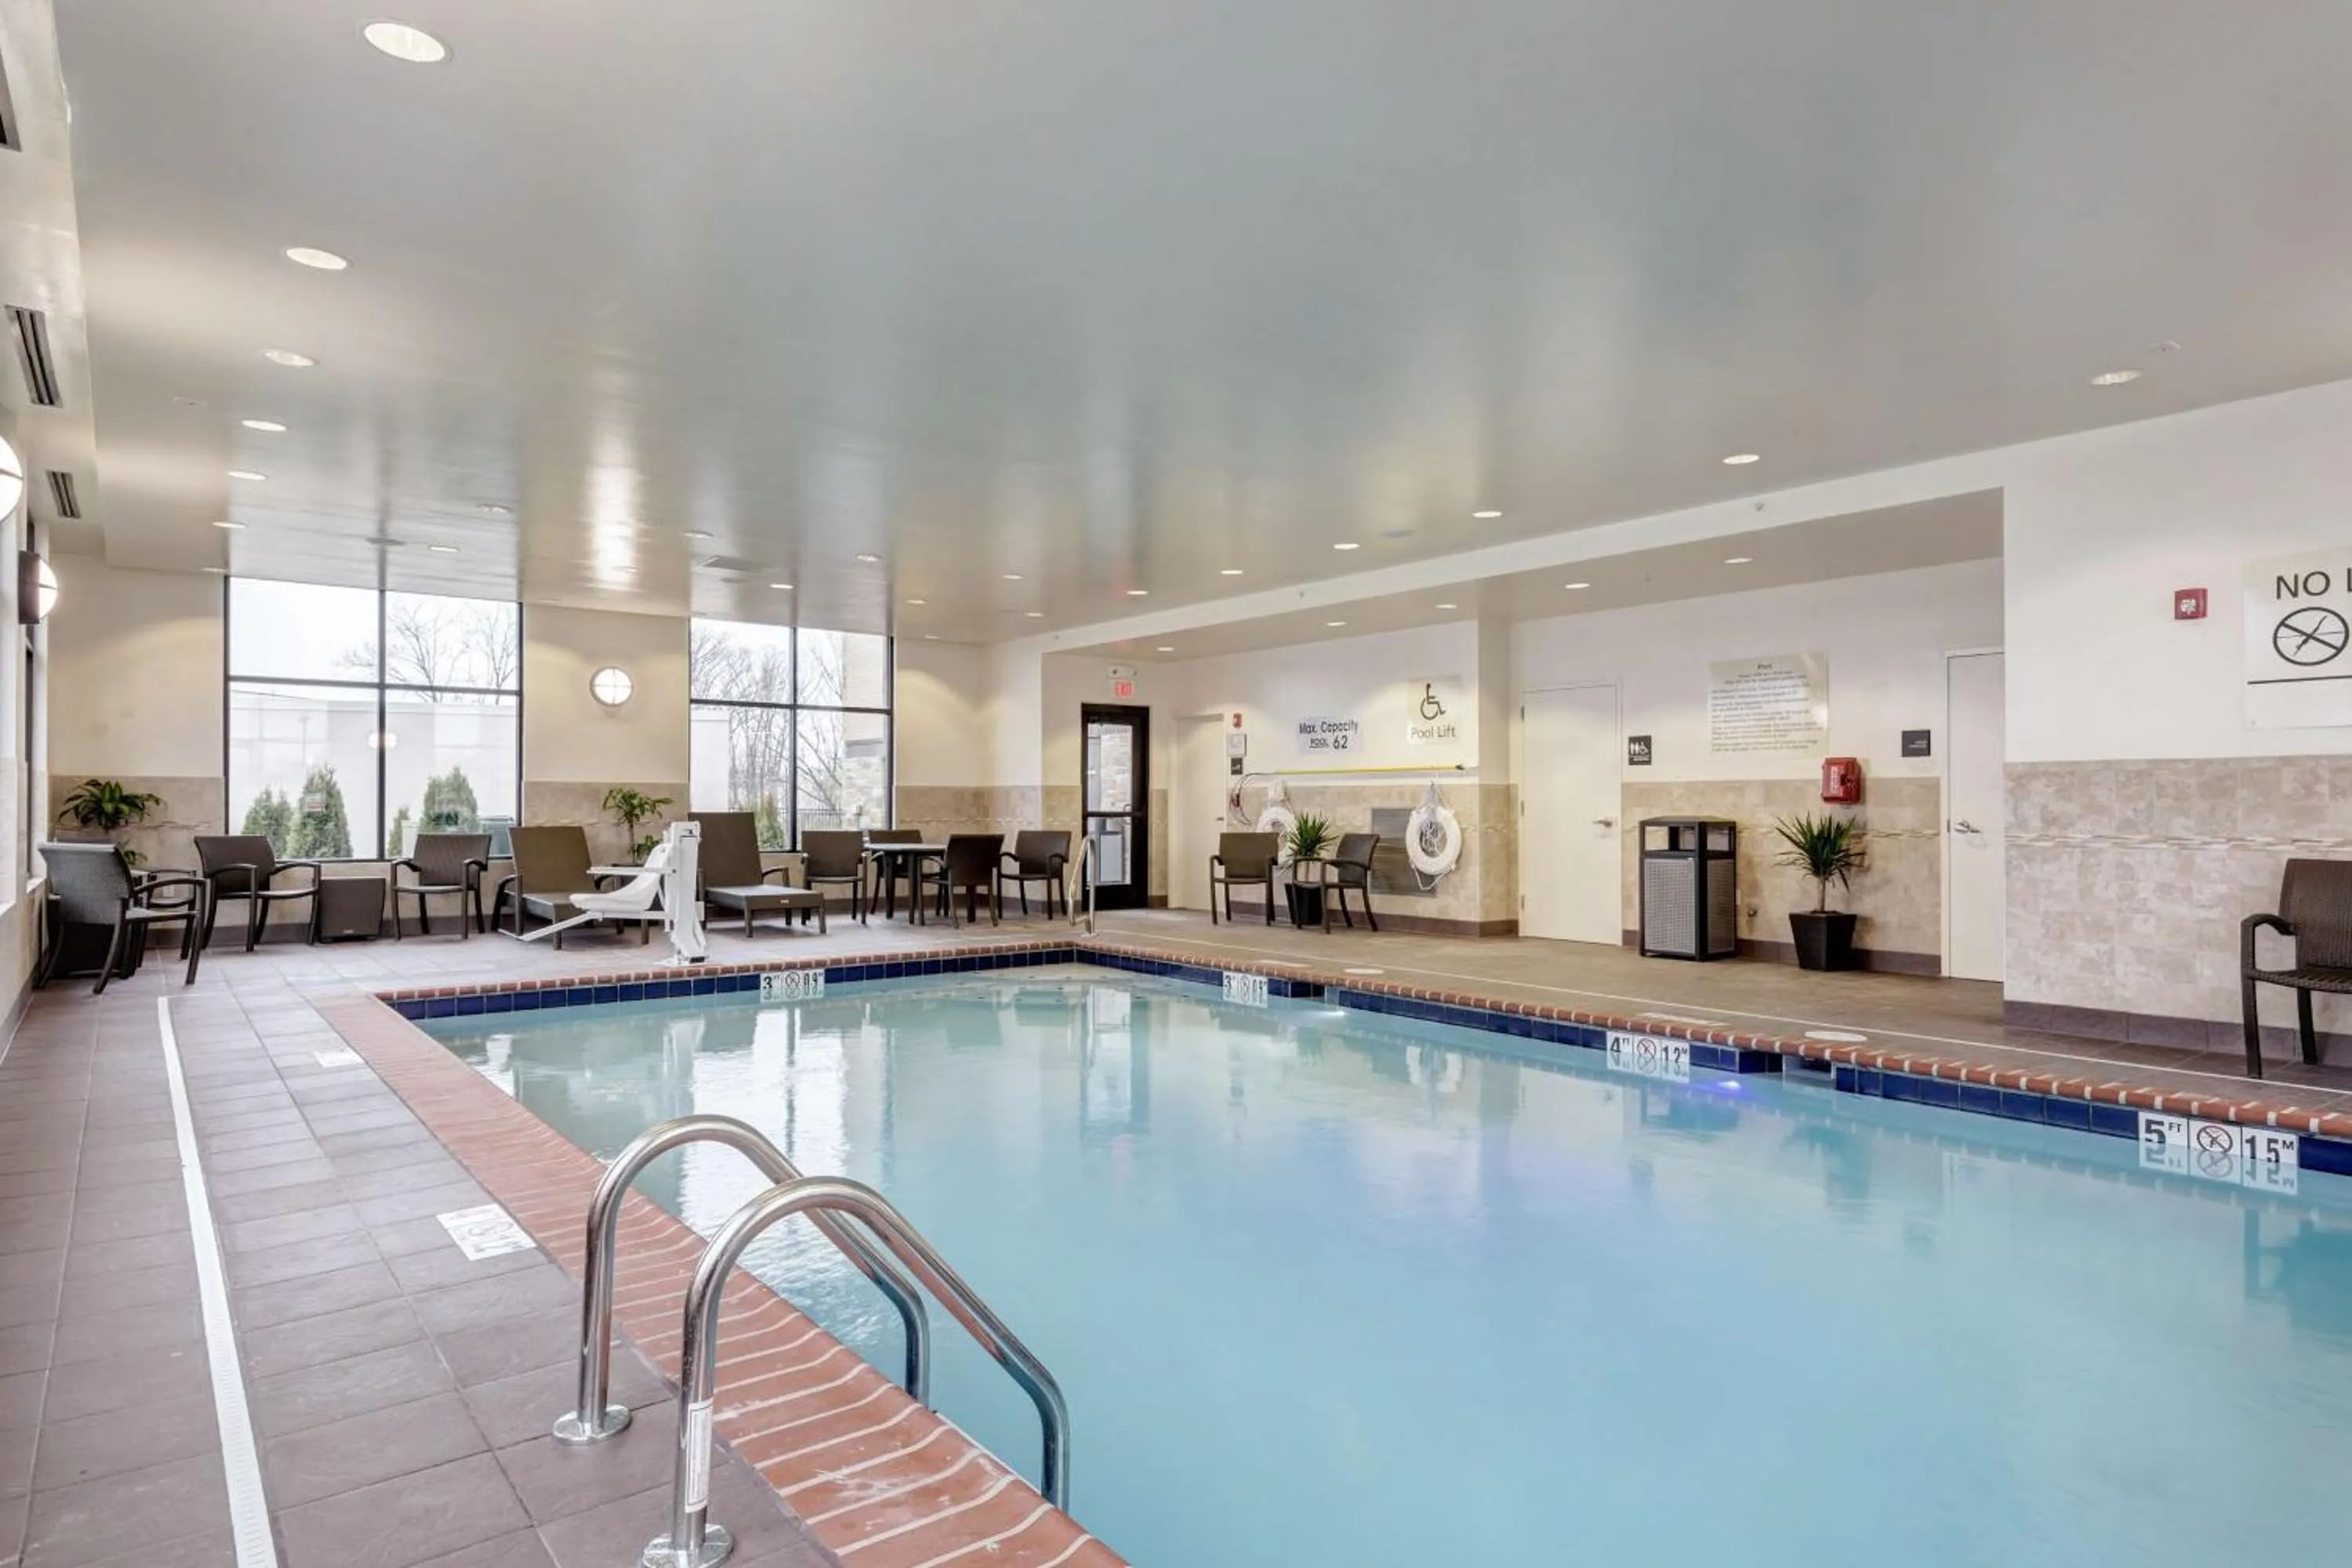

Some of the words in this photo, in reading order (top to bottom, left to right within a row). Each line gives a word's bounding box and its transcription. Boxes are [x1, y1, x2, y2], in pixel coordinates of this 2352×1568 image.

[2276, 571, 2331, 600] NO
[1321, 719, 1358, 735] Capacity
[1410, 726, 1433, 739] Pool
[1437, 724, 1456, 737] Lift
[1334, 735, 1348, 750] 62
[763, 976, 772, 989] 3
[1610, 1036, 1621, 1053] 4
[2145, 1119, 2166, 1144] 5
[2282, 1139, 2295, 1151] M
